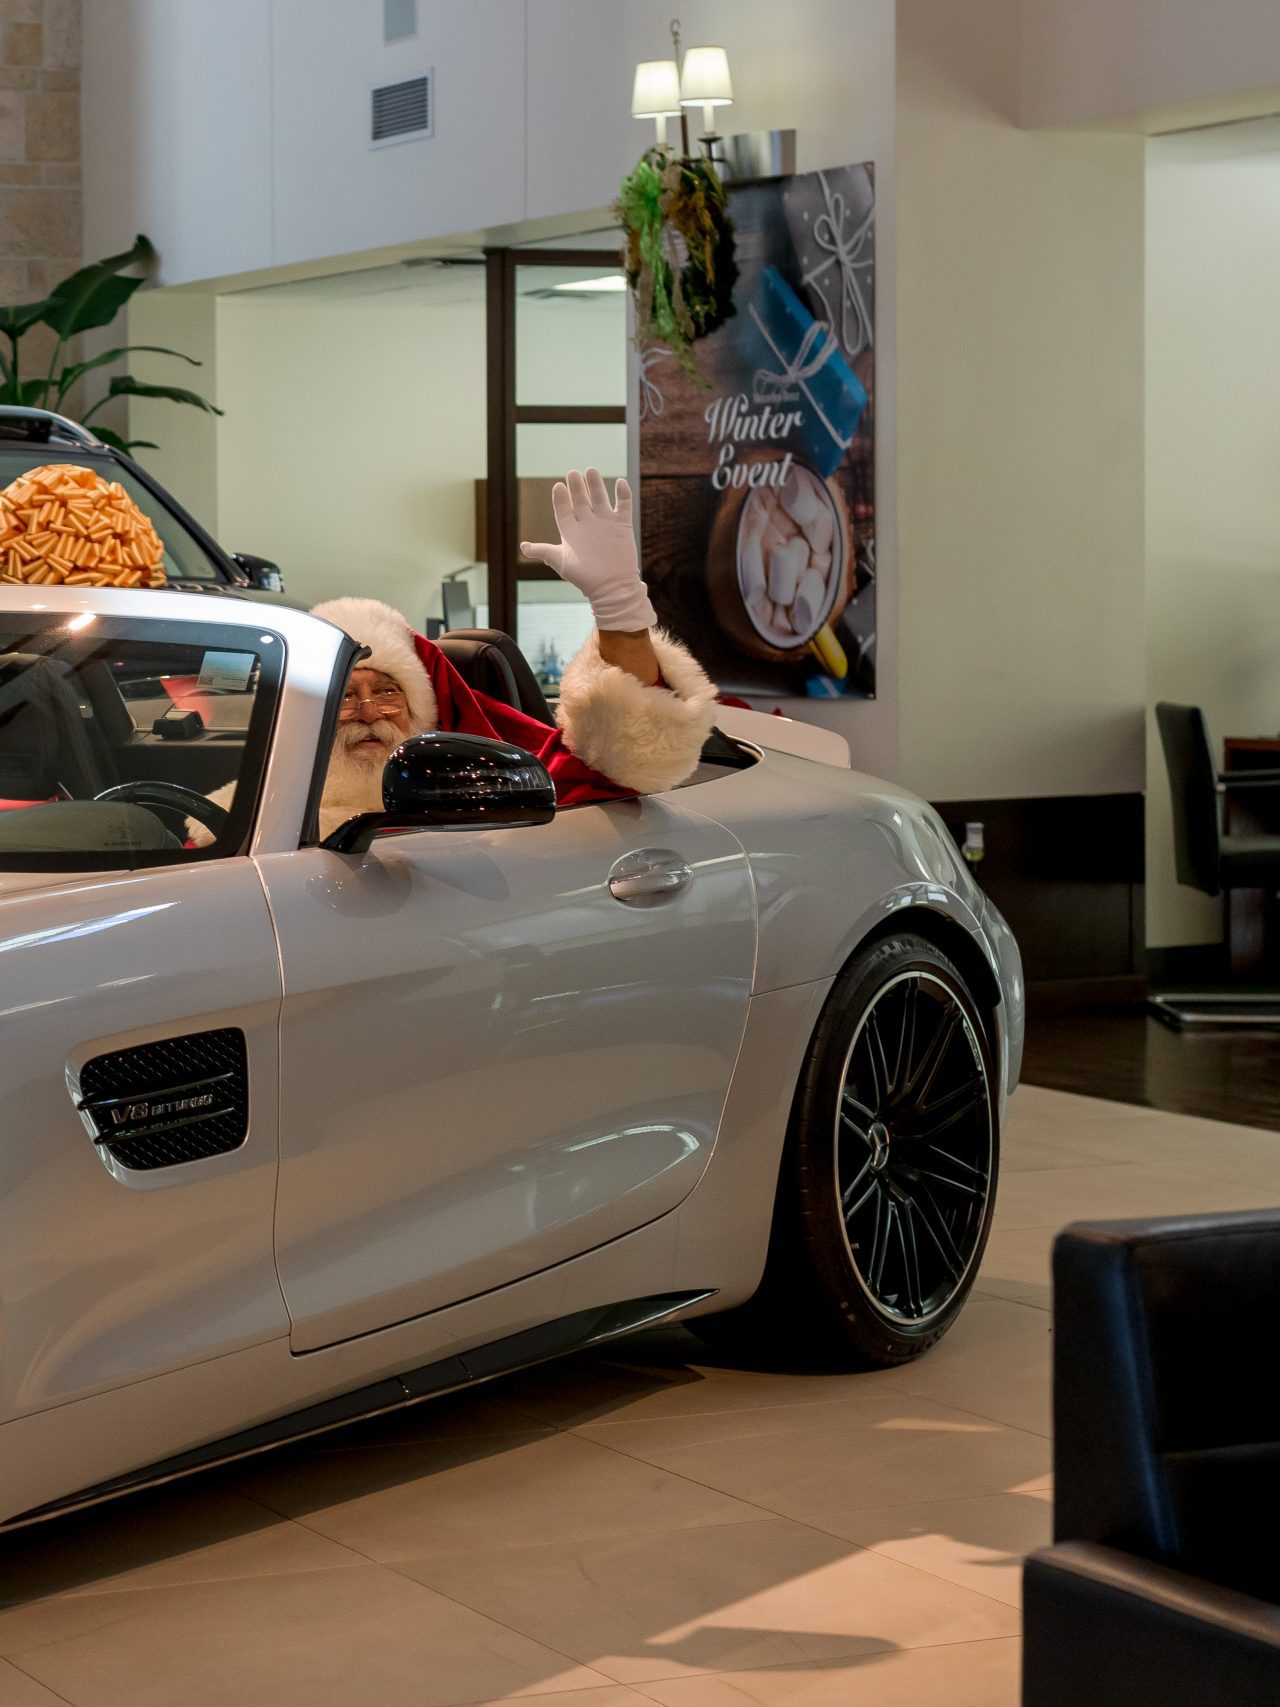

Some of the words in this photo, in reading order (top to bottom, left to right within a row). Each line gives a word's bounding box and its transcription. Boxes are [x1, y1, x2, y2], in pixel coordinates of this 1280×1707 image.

[704, 393, 805, 443] Winter
[711, 443, 793, 491] Event
[111, 1103, 149, 1125] V8
[151, 1093, 214, 1116] BITURBO
